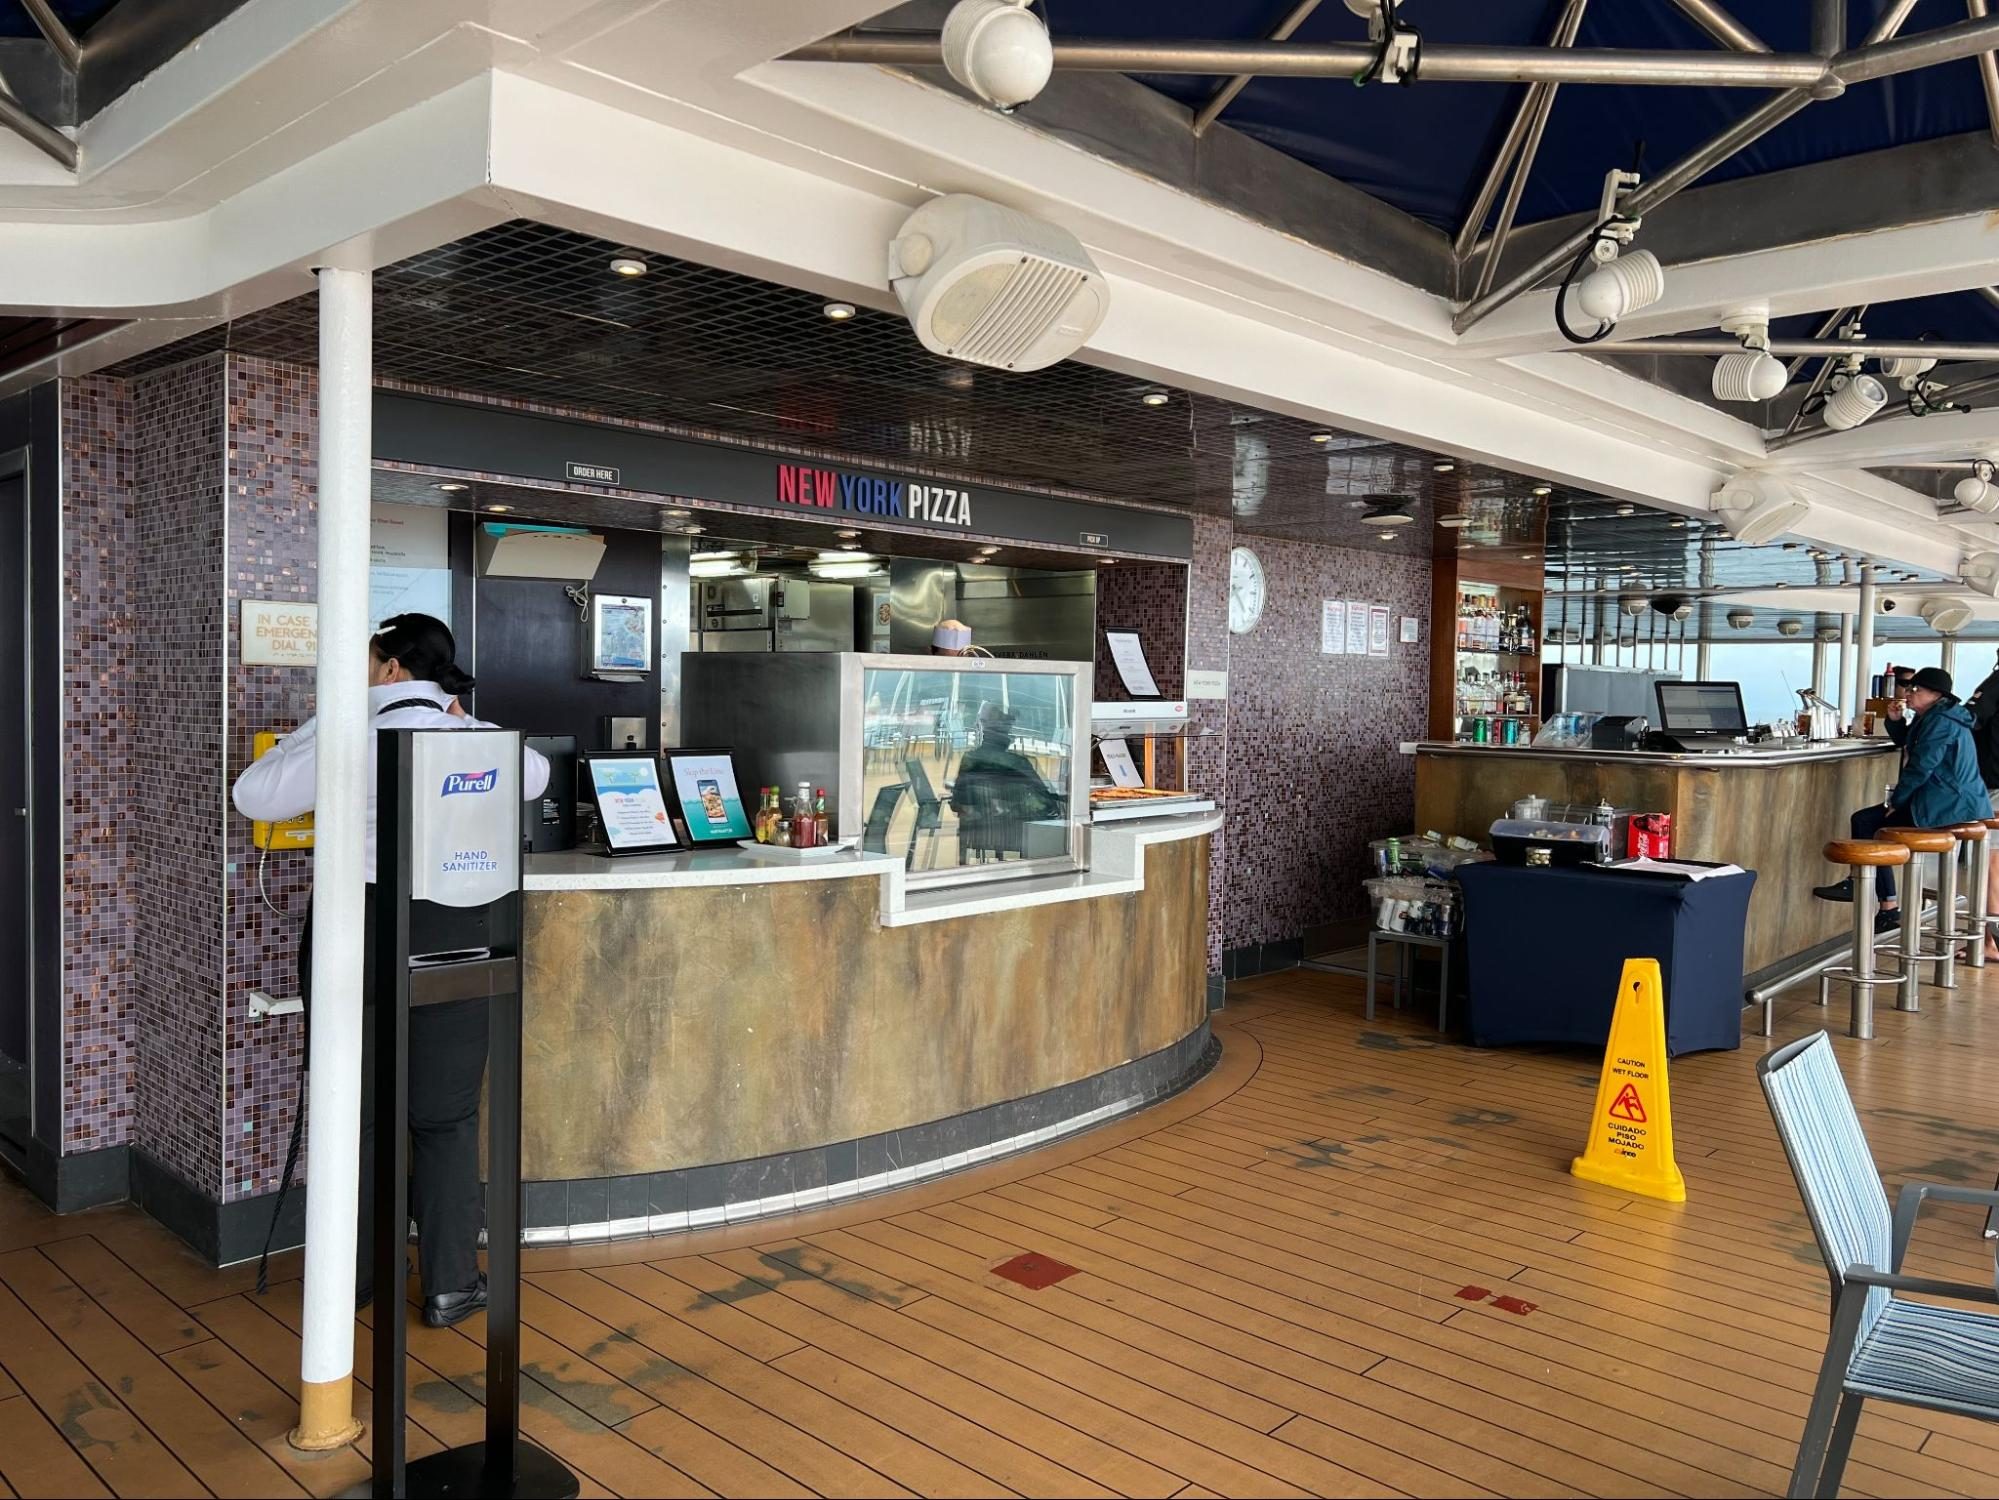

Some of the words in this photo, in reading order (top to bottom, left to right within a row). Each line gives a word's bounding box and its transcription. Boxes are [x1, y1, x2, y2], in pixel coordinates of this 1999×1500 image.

[573, 466, 595, 478] ORDER
[596, 469, 613, 481] HERE
[778, 464, 836, 509] NEW
[838, 474, 902, 517] YORK
[907, 483, 972, 526] PIZZA
[257, 614, 271, 625] IN
[276, 615, 311, 627] CASE
[272, 639, 300, 651] DIAL
[448, 774, 493, 792] Purell
[454, 851, 488, 861] HAND
[442, 861, 497, 872] SANITIZER
[1617, 1058, 1645, 1068] CAUTION
[1612, 1067, 1626, 1075] WET
[1627, 1070, 1649, 1079] FLOOR
[1608, 1122, 1647, 1136] CUIDADO
[1616, 1132, 1637, 1141] PISO
[1608, 1137, 1645, 1150] MOJADO
